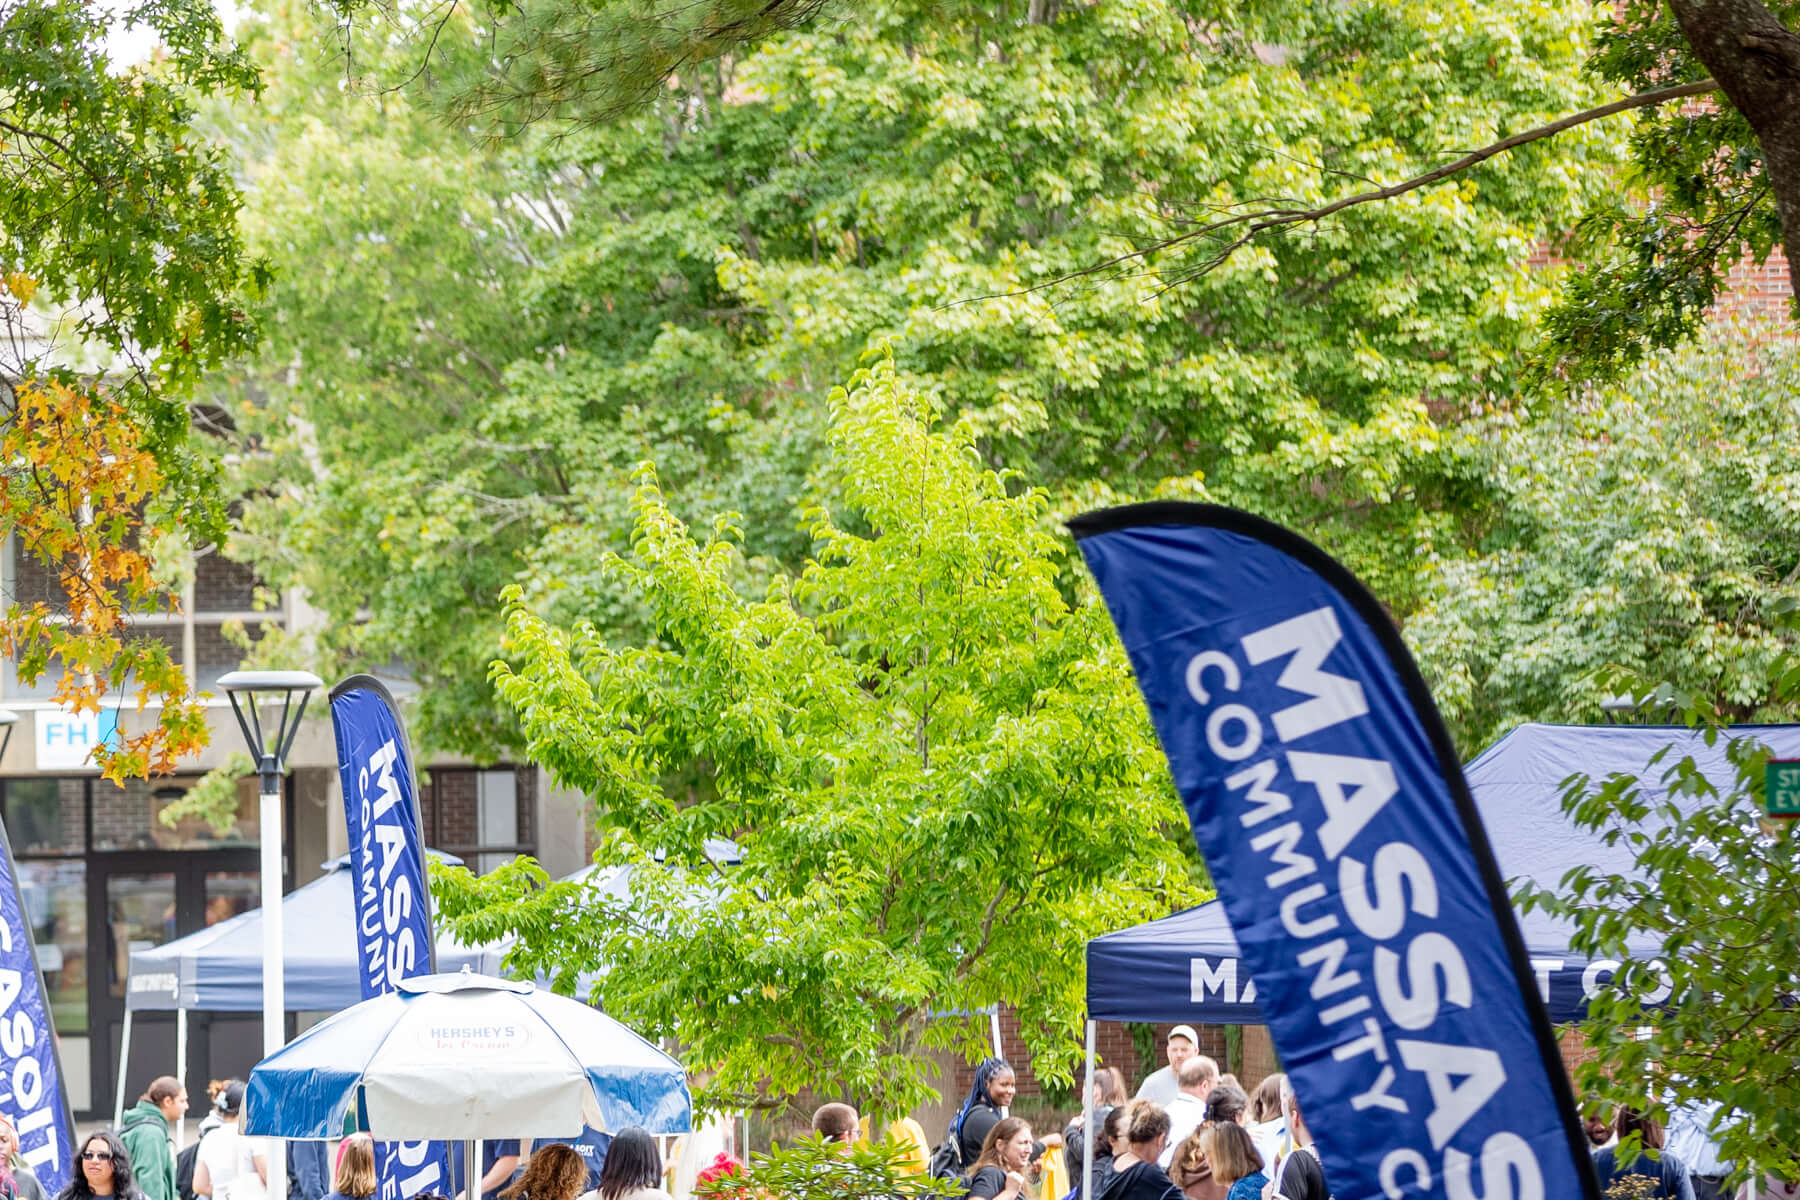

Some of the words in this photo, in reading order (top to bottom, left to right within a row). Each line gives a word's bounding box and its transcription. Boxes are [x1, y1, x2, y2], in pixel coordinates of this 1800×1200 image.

[46, 723, 88, 745] FH
[358, 766, 387, 996] COMMUNI
[1186, 650, 1410, 1115] COMMUNITY
